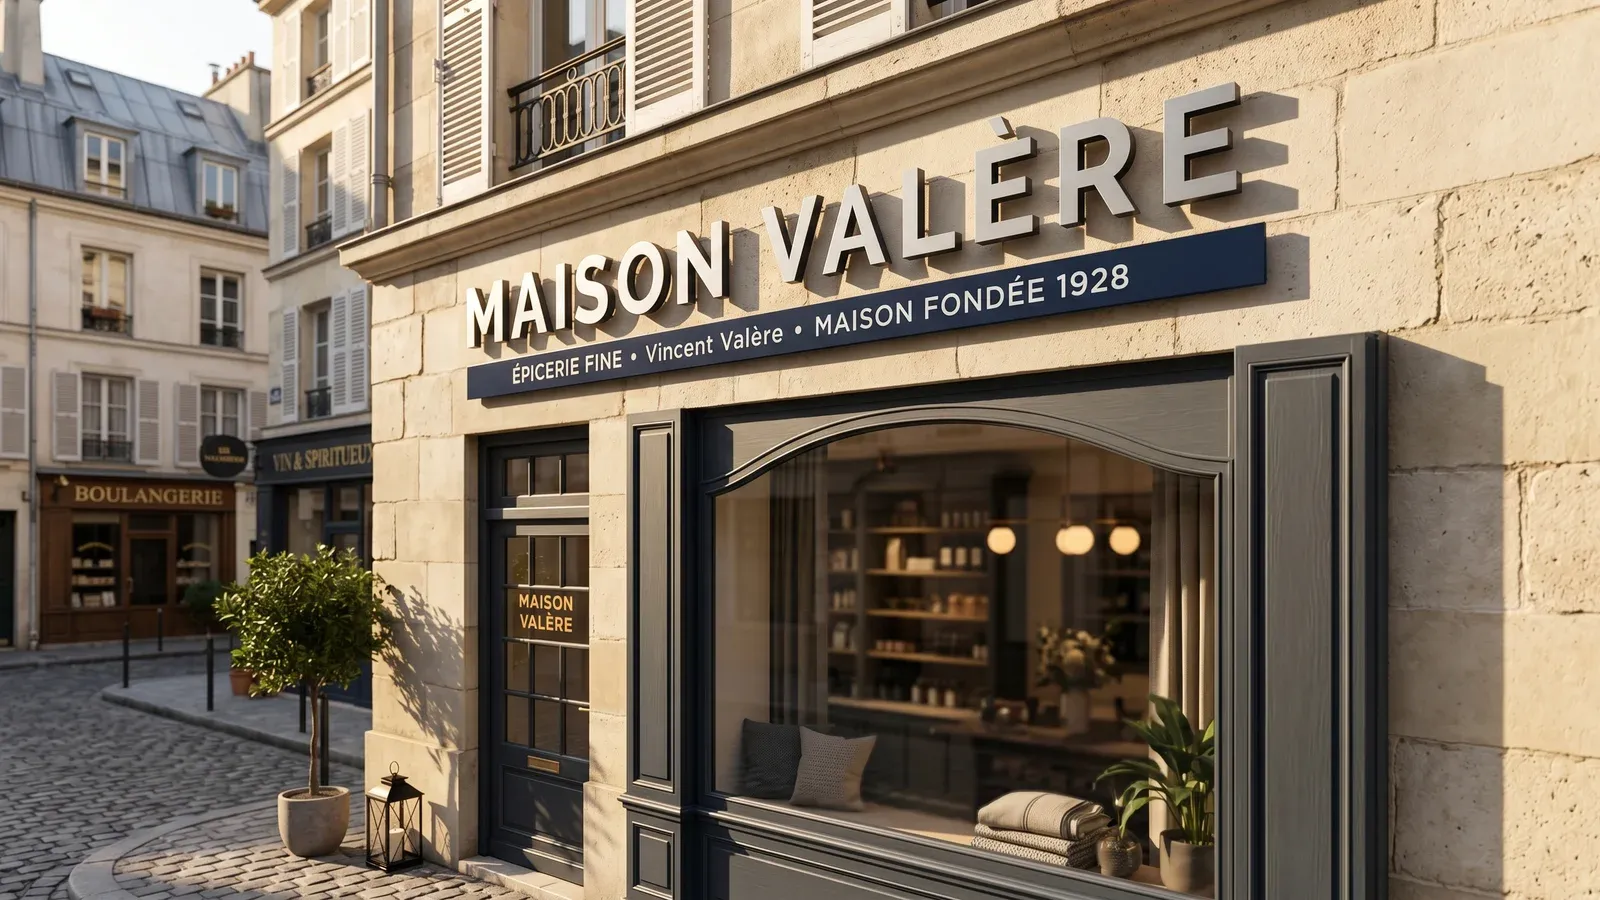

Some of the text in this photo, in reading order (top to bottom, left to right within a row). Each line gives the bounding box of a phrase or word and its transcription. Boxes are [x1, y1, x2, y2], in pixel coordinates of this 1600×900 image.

[466, 81, 1242, 349] MAISON VALÈRE
[512, 263, 1130, 385] ÉPICERIE FINE Vincent Valère MAISON FONDÉE 1928
[272, 452, 293, 472] VIN
[293, 451, 304, 471] &
[74, 485, 224, 506] BOULANGERIE
[519, 594, 573, 611] MAISON
[520, 611, 573, 632] VALÈRE
